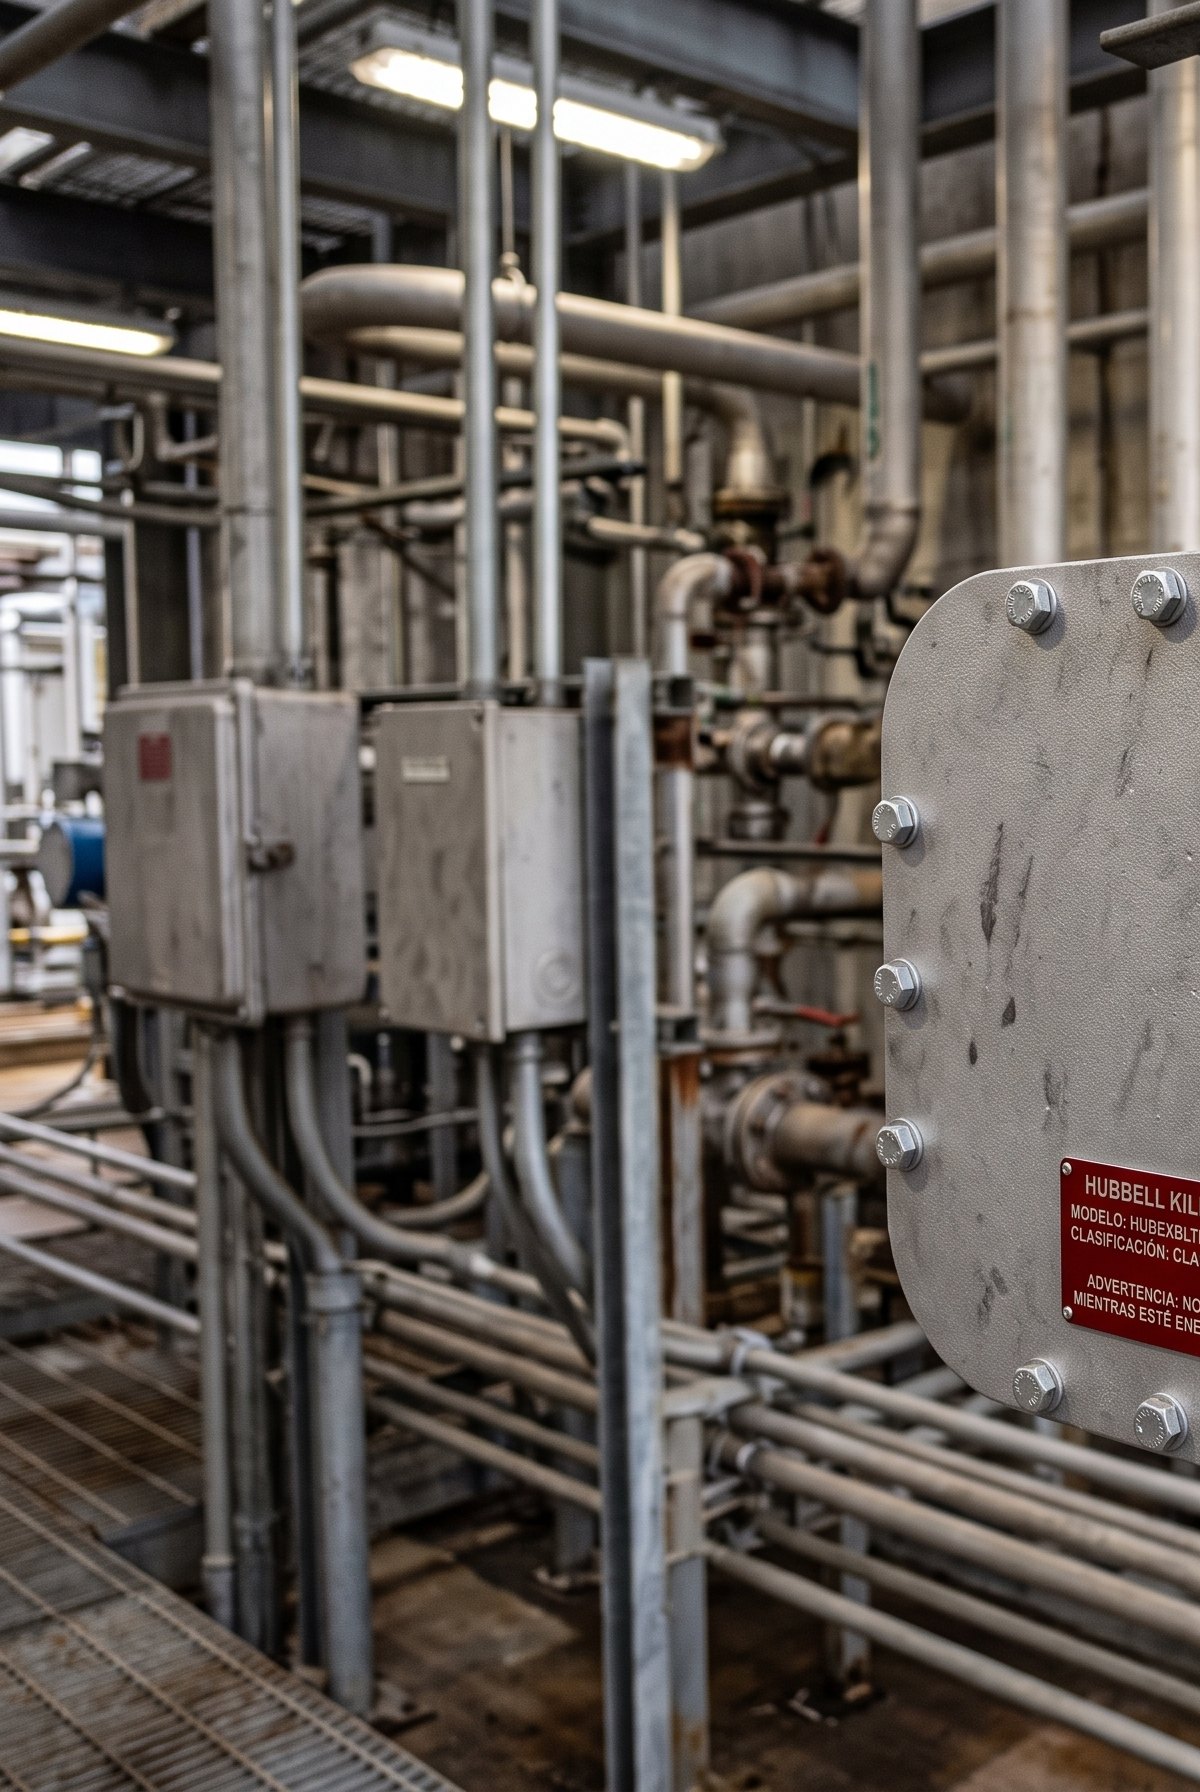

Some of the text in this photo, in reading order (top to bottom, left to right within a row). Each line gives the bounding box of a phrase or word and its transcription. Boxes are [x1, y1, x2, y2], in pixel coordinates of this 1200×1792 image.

[1085, 1174, 1165, 1209] HUBBELL
[1071, 1204, 1126, 1229] MODELO:
[1071, 1225, 1169, 1260] CLASIFICACIÓN:
[1074, 1291, 1136, 1319] MIENTRAS
[1140, 1307, 1172, 1328] ESTÉ
[1087, 1274, 1178, 1308] ADVERTENCIA:
[1183, 1296, 1200, 1313] NO
